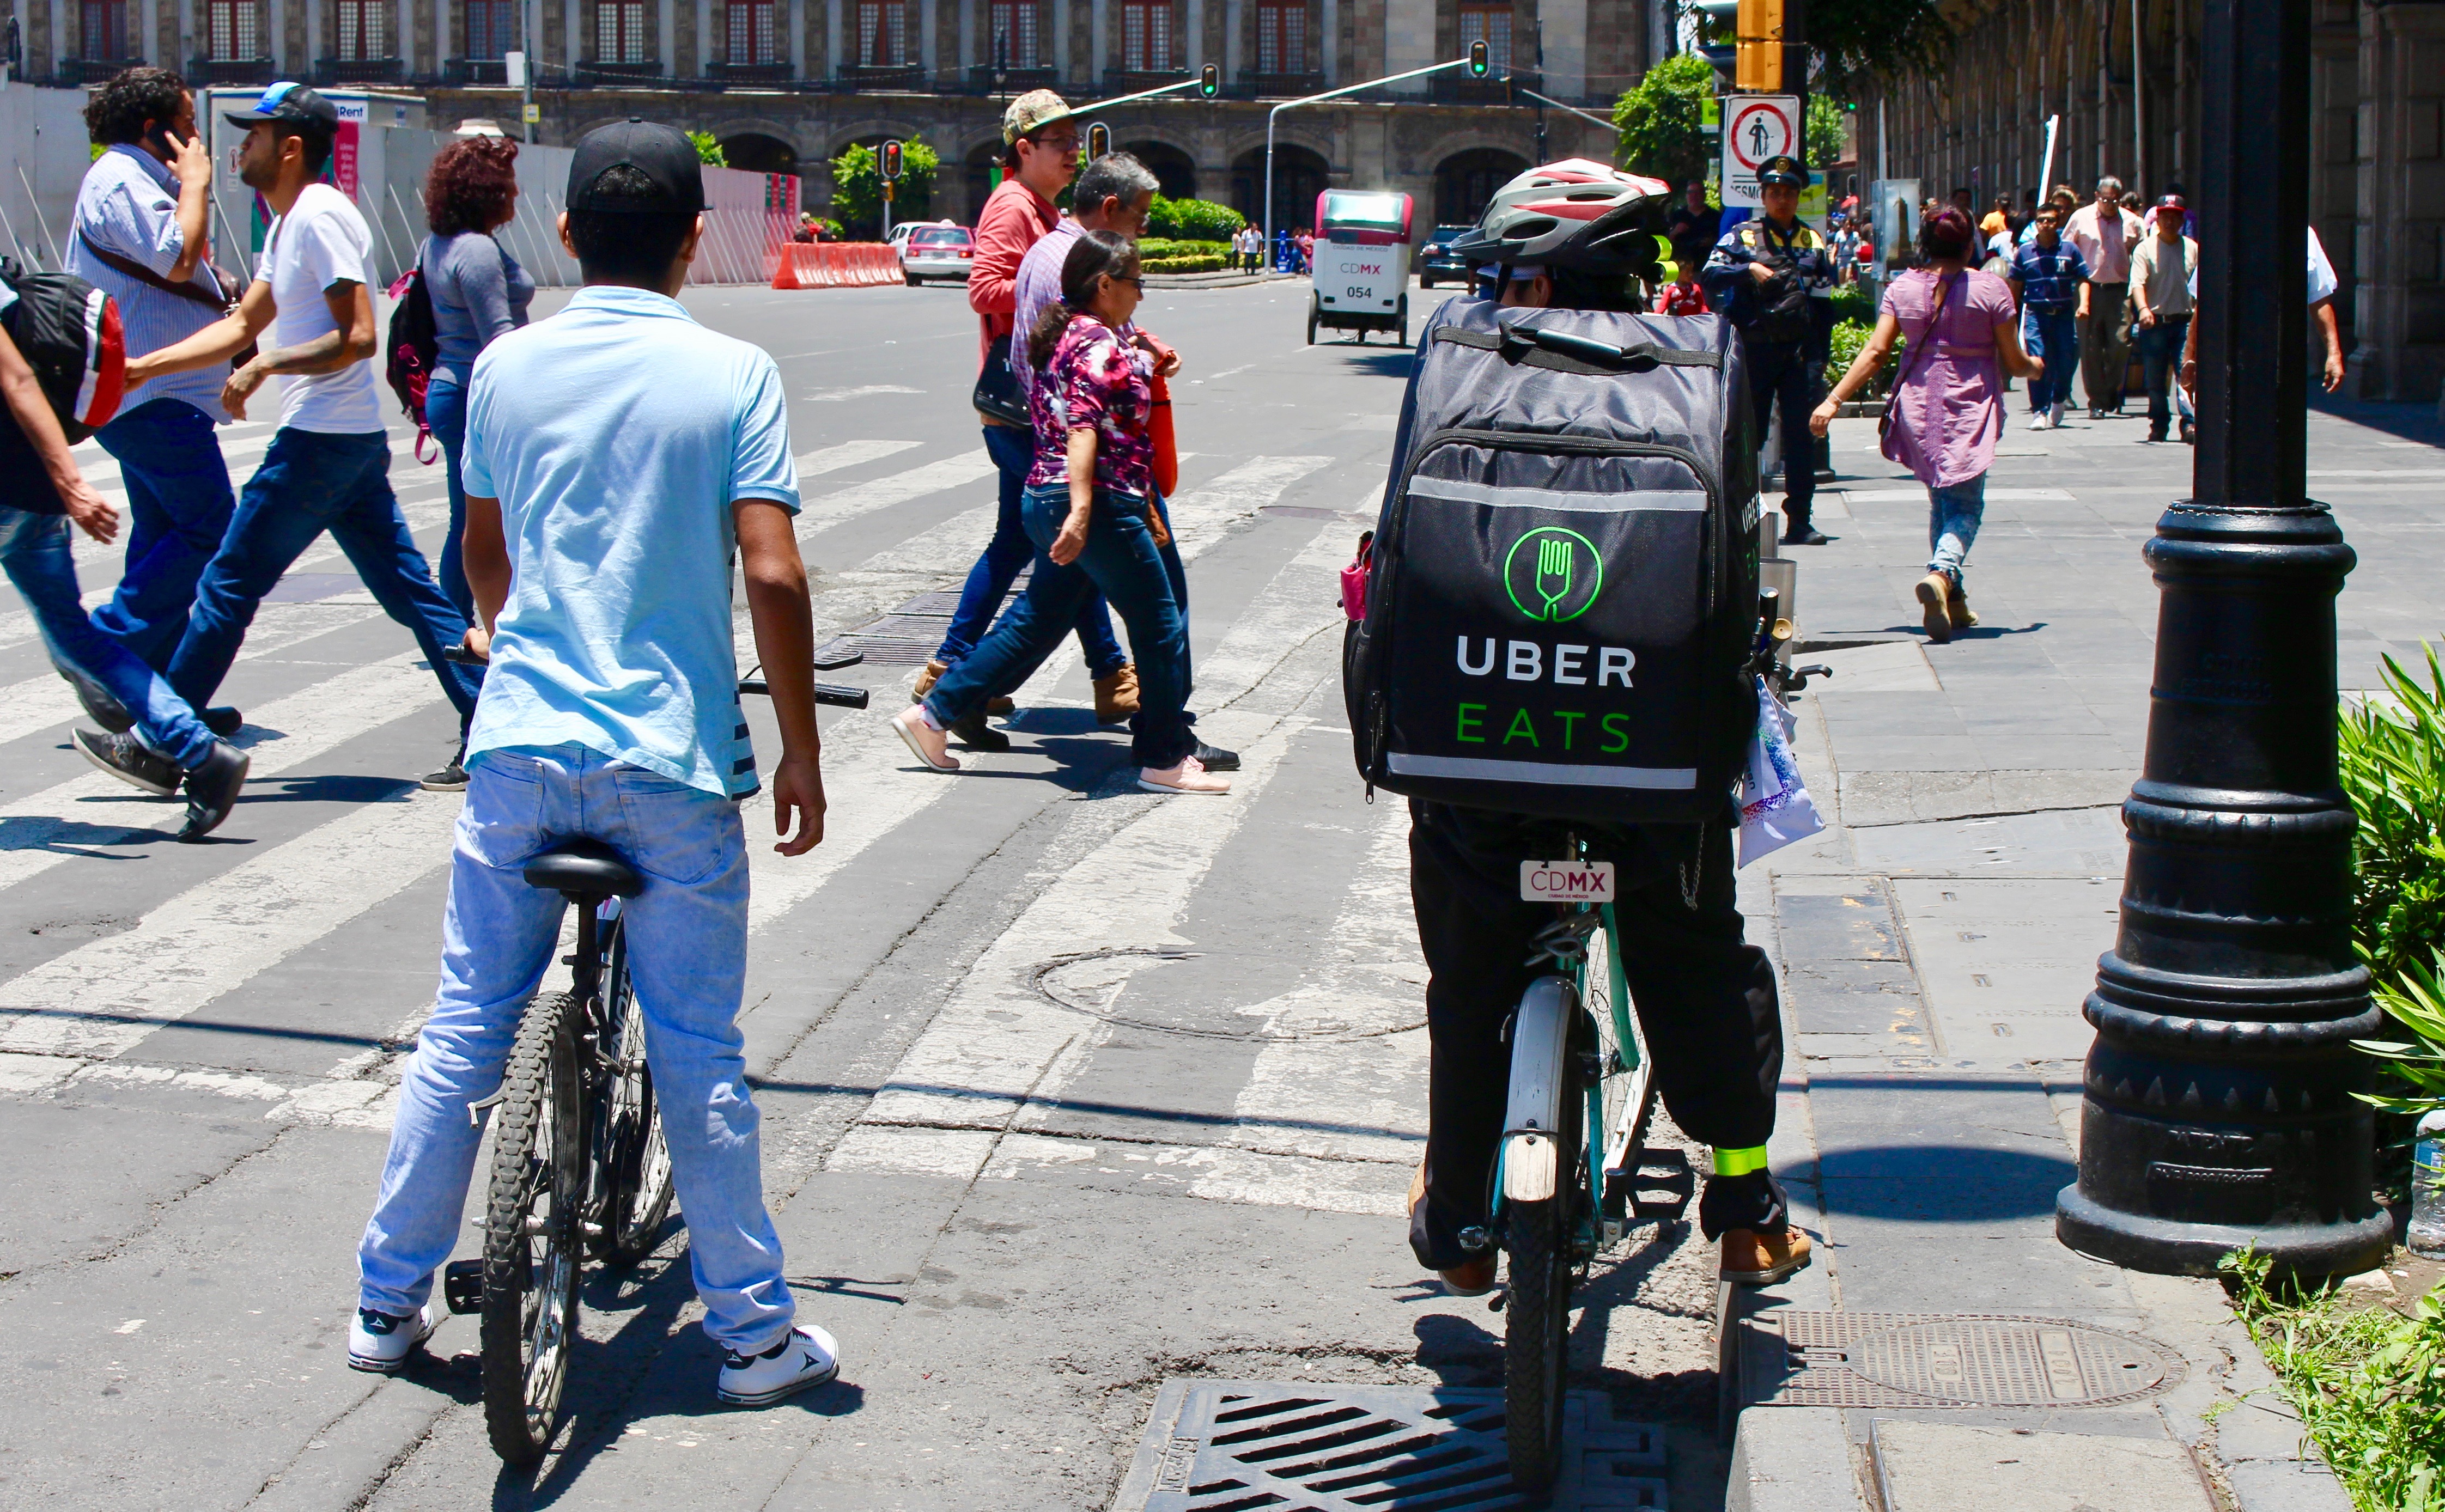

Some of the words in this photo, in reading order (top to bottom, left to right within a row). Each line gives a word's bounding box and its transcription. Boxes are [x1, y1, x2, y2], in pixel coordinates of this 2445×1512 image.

[1730, 185, 1762, 200] ESM
[1340, 263, 1381, 275] CDMX
[1347, 286, 1372, 298] 054
[1457, 636, 1635, 688] UBER
[1457, 703, 1629, 753] EATS
[1531, 871, 1605, 892] CDMX
